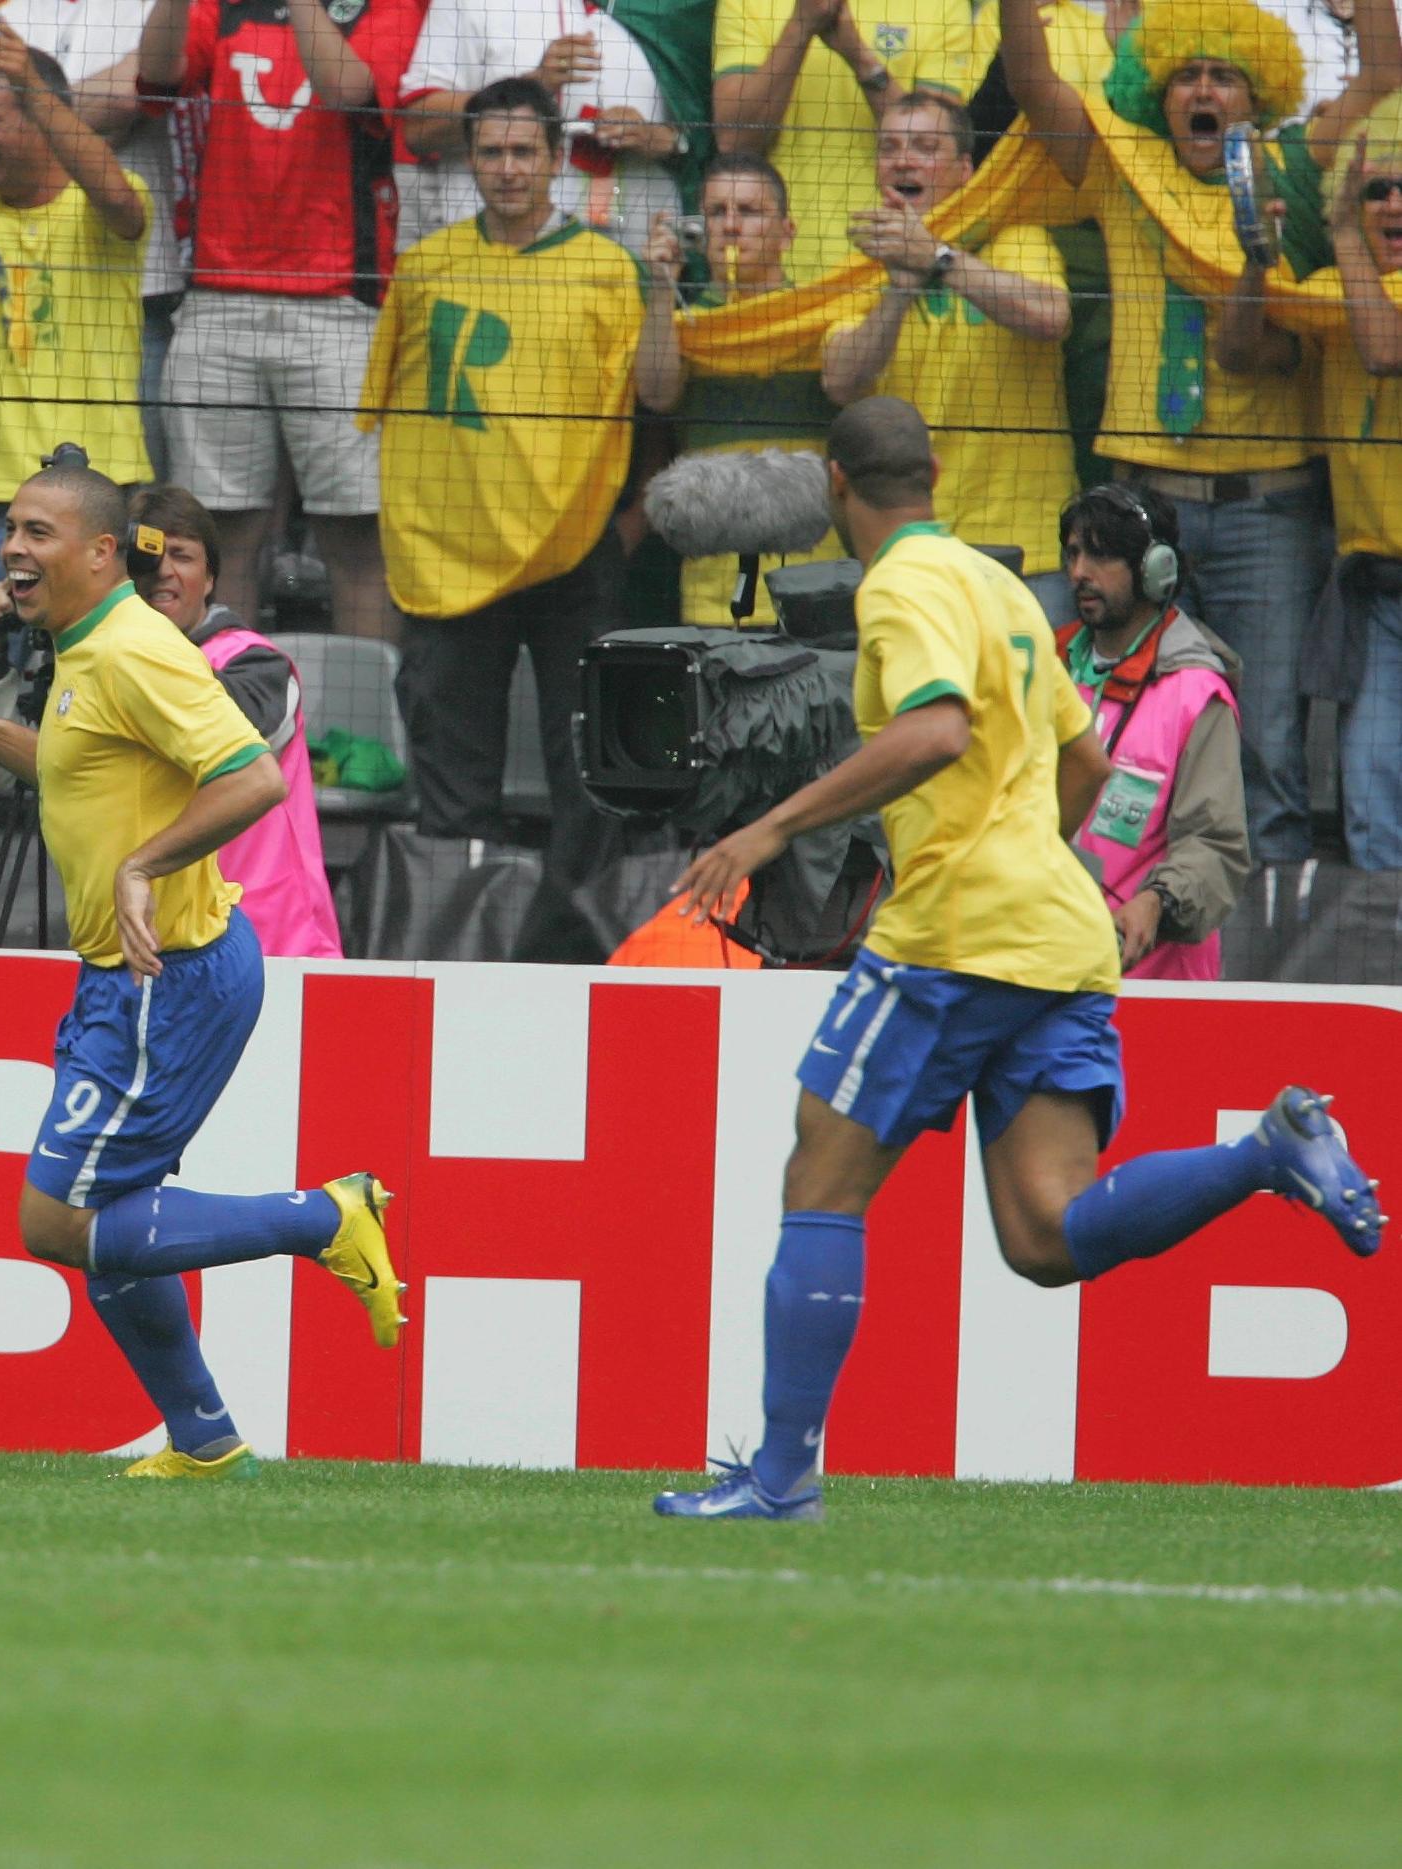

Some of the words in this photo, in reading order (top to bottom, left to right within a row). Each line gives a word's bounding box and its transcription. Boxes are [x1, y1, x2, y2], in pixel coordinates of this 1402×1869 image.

[1009, 632, 1037, 712] 7
[833, 969, 877, 1031] 7
[54, 1079, 102, 1134] 9
